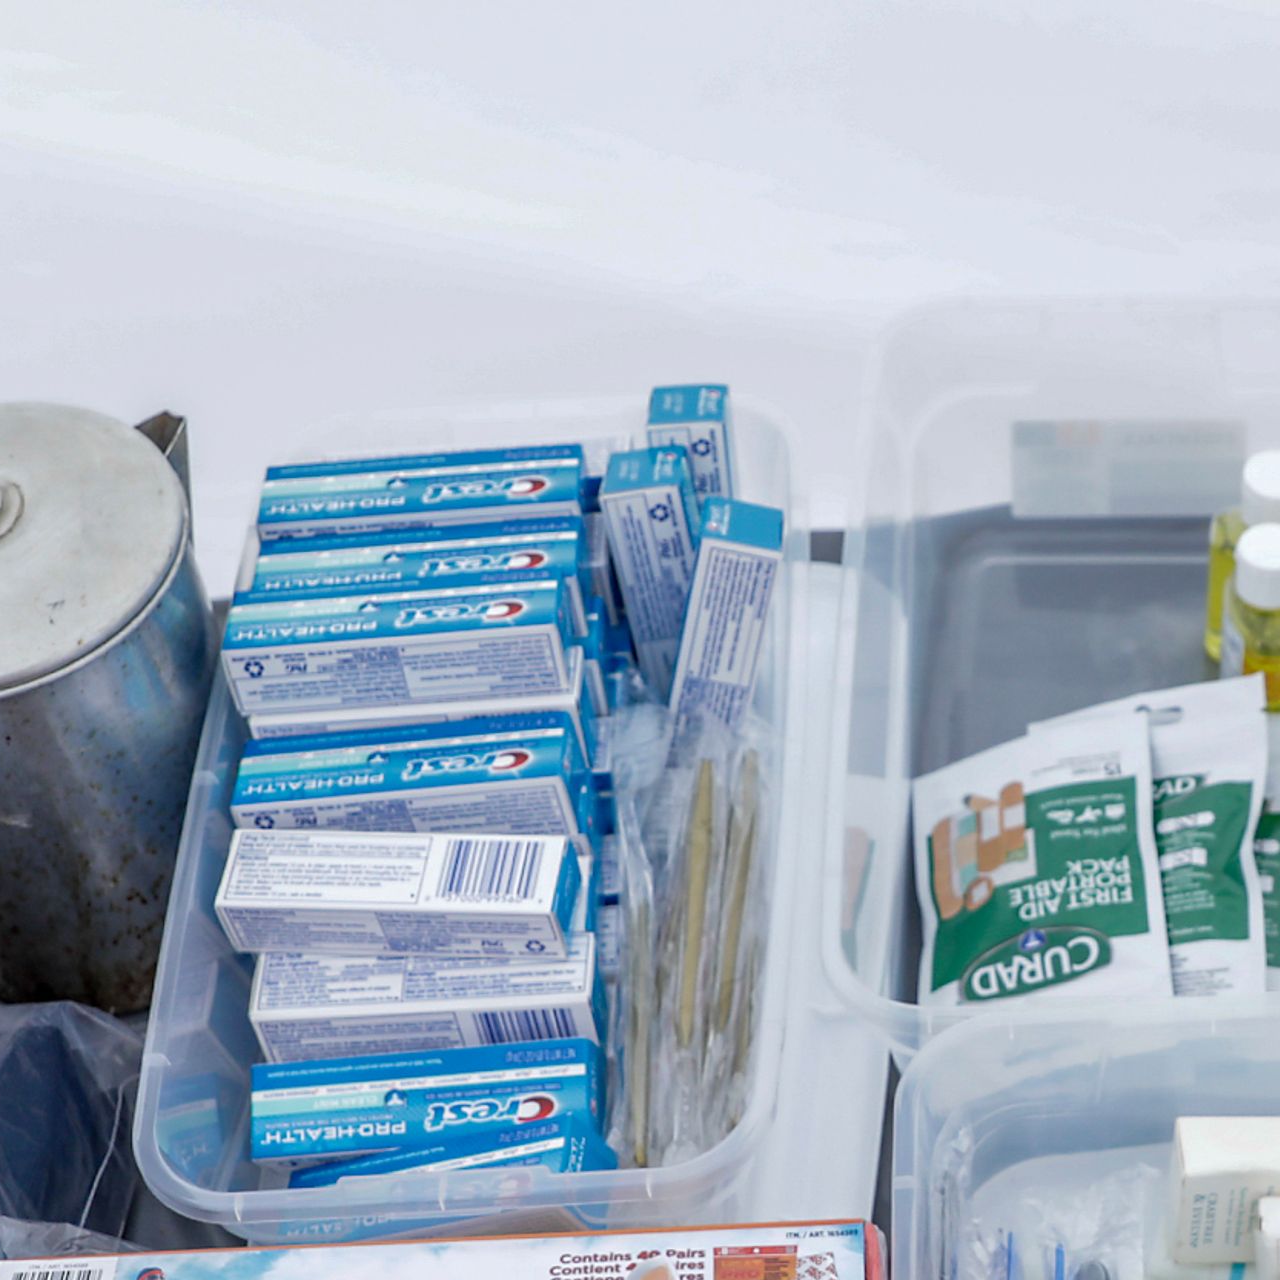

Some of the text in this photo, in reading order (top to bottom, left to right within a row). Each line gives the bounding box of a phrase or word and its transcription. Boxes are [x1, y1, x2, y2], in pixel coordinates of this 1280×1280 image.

[394, 599, 523, 628] Crest
[231, 619, 378, 642] PRO-HEALTH
[401, 749, 531, 782] Crest
[241, 772, 384, 797] PRO-HEALTH
[1066, 855, 1130, 875] PACK
[1009, 871, 1132, 908] PORTABLE
[1020, 886, 1133, 922] FIRST AID
[970, 934, 1101, 996] CURAD
[425, 1094, 556, 1131] Crest
[260, 1120, 406, 1144] PRO-HEALTH
[549, 1263, 622, 1277] Contient
[559, 1251, 632, 1265] Contains
